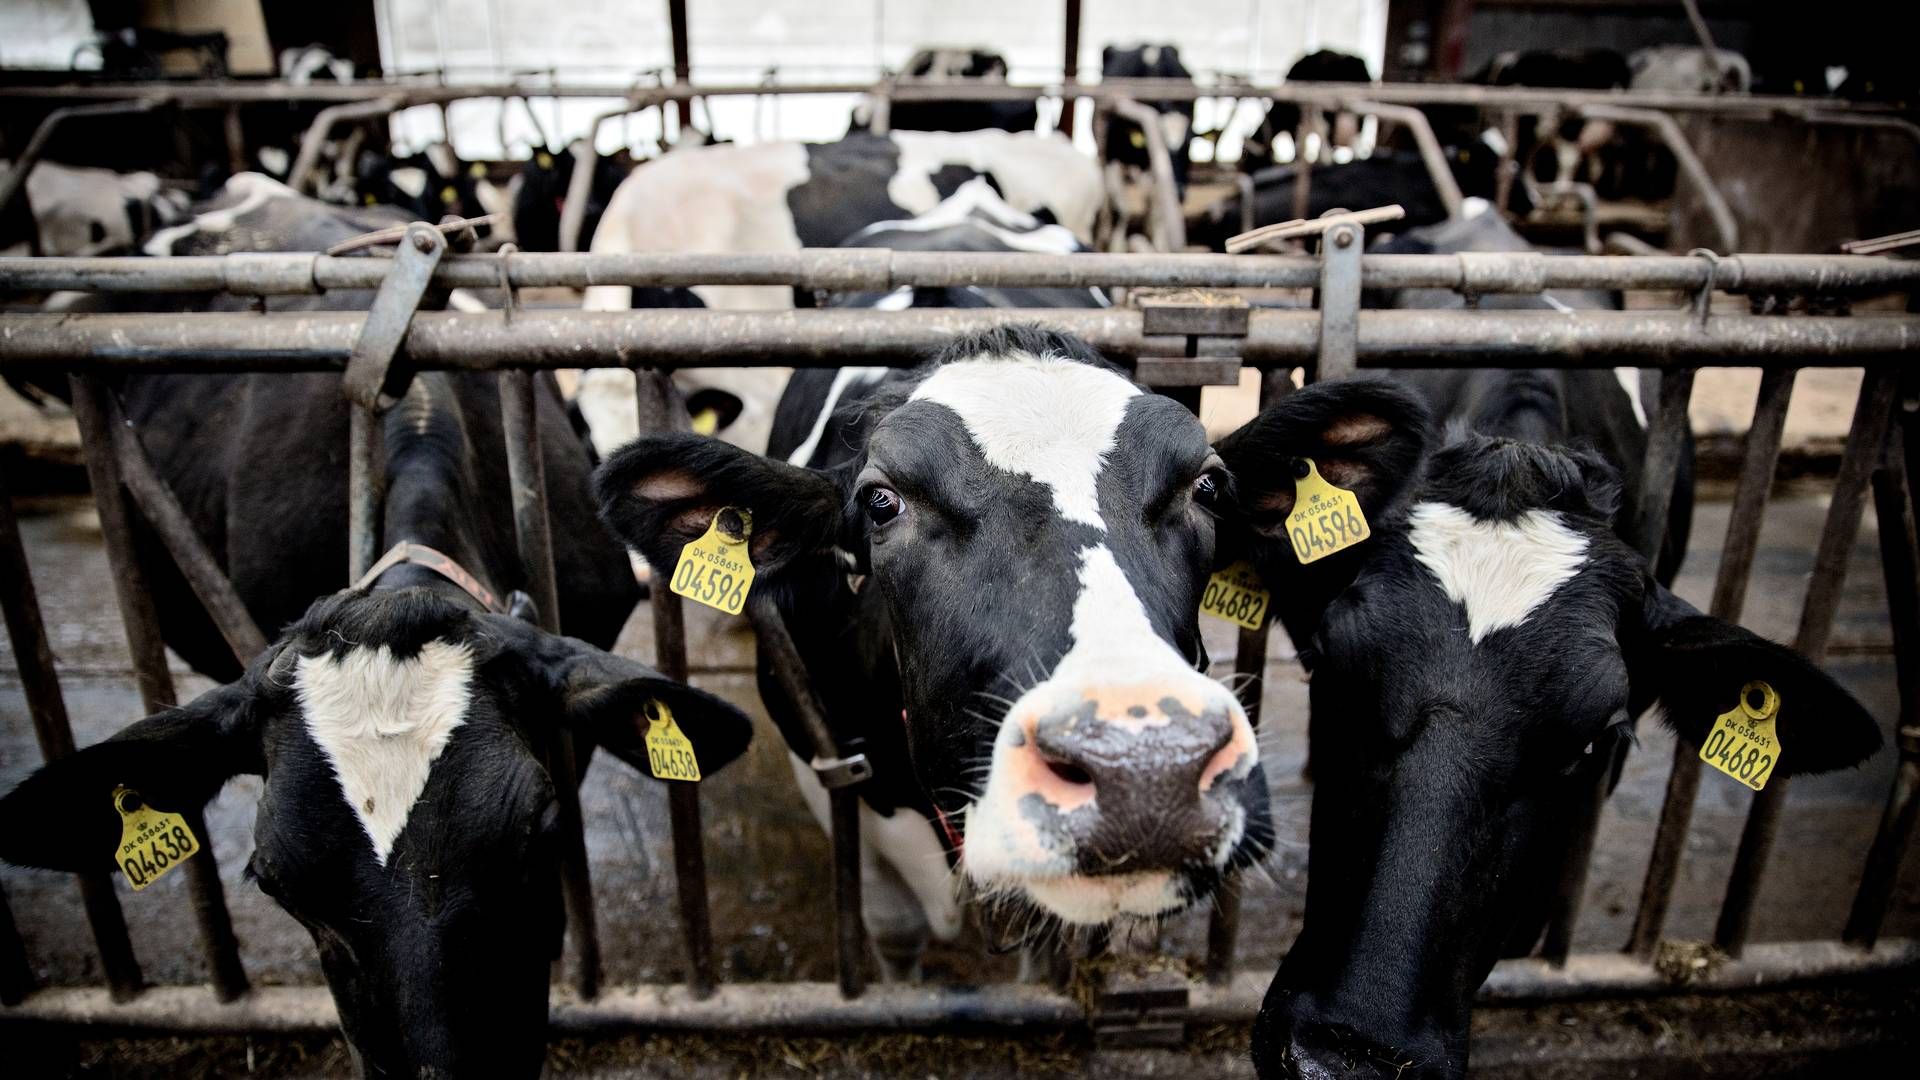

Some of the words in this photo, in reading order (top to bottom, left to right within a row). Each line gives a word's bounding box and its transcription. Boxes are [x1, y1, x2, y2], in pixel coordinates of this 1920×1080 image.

[1294, 511, 1307, 522] DK
[1308, 495, 1343, 516] 058631
[1293, 505, 1362, 559] 04596
[693, 547, 706, 559] DK
[707, 553, 743, 574] 058631
[676, 559, 745, 611] 04596
[1204, 583, 1263, 626] 04682
[1725, 719, 1737, 731] DK
[1738, 726, 1771, 749] 058631
[651, 748, 697, 778] 04638
[1705, 729, 1771, 788] 04682
[123, 841, 136, 854] DK
[137, 818, 171, 844] 058631
[124, 825, 192, 886] 04638
